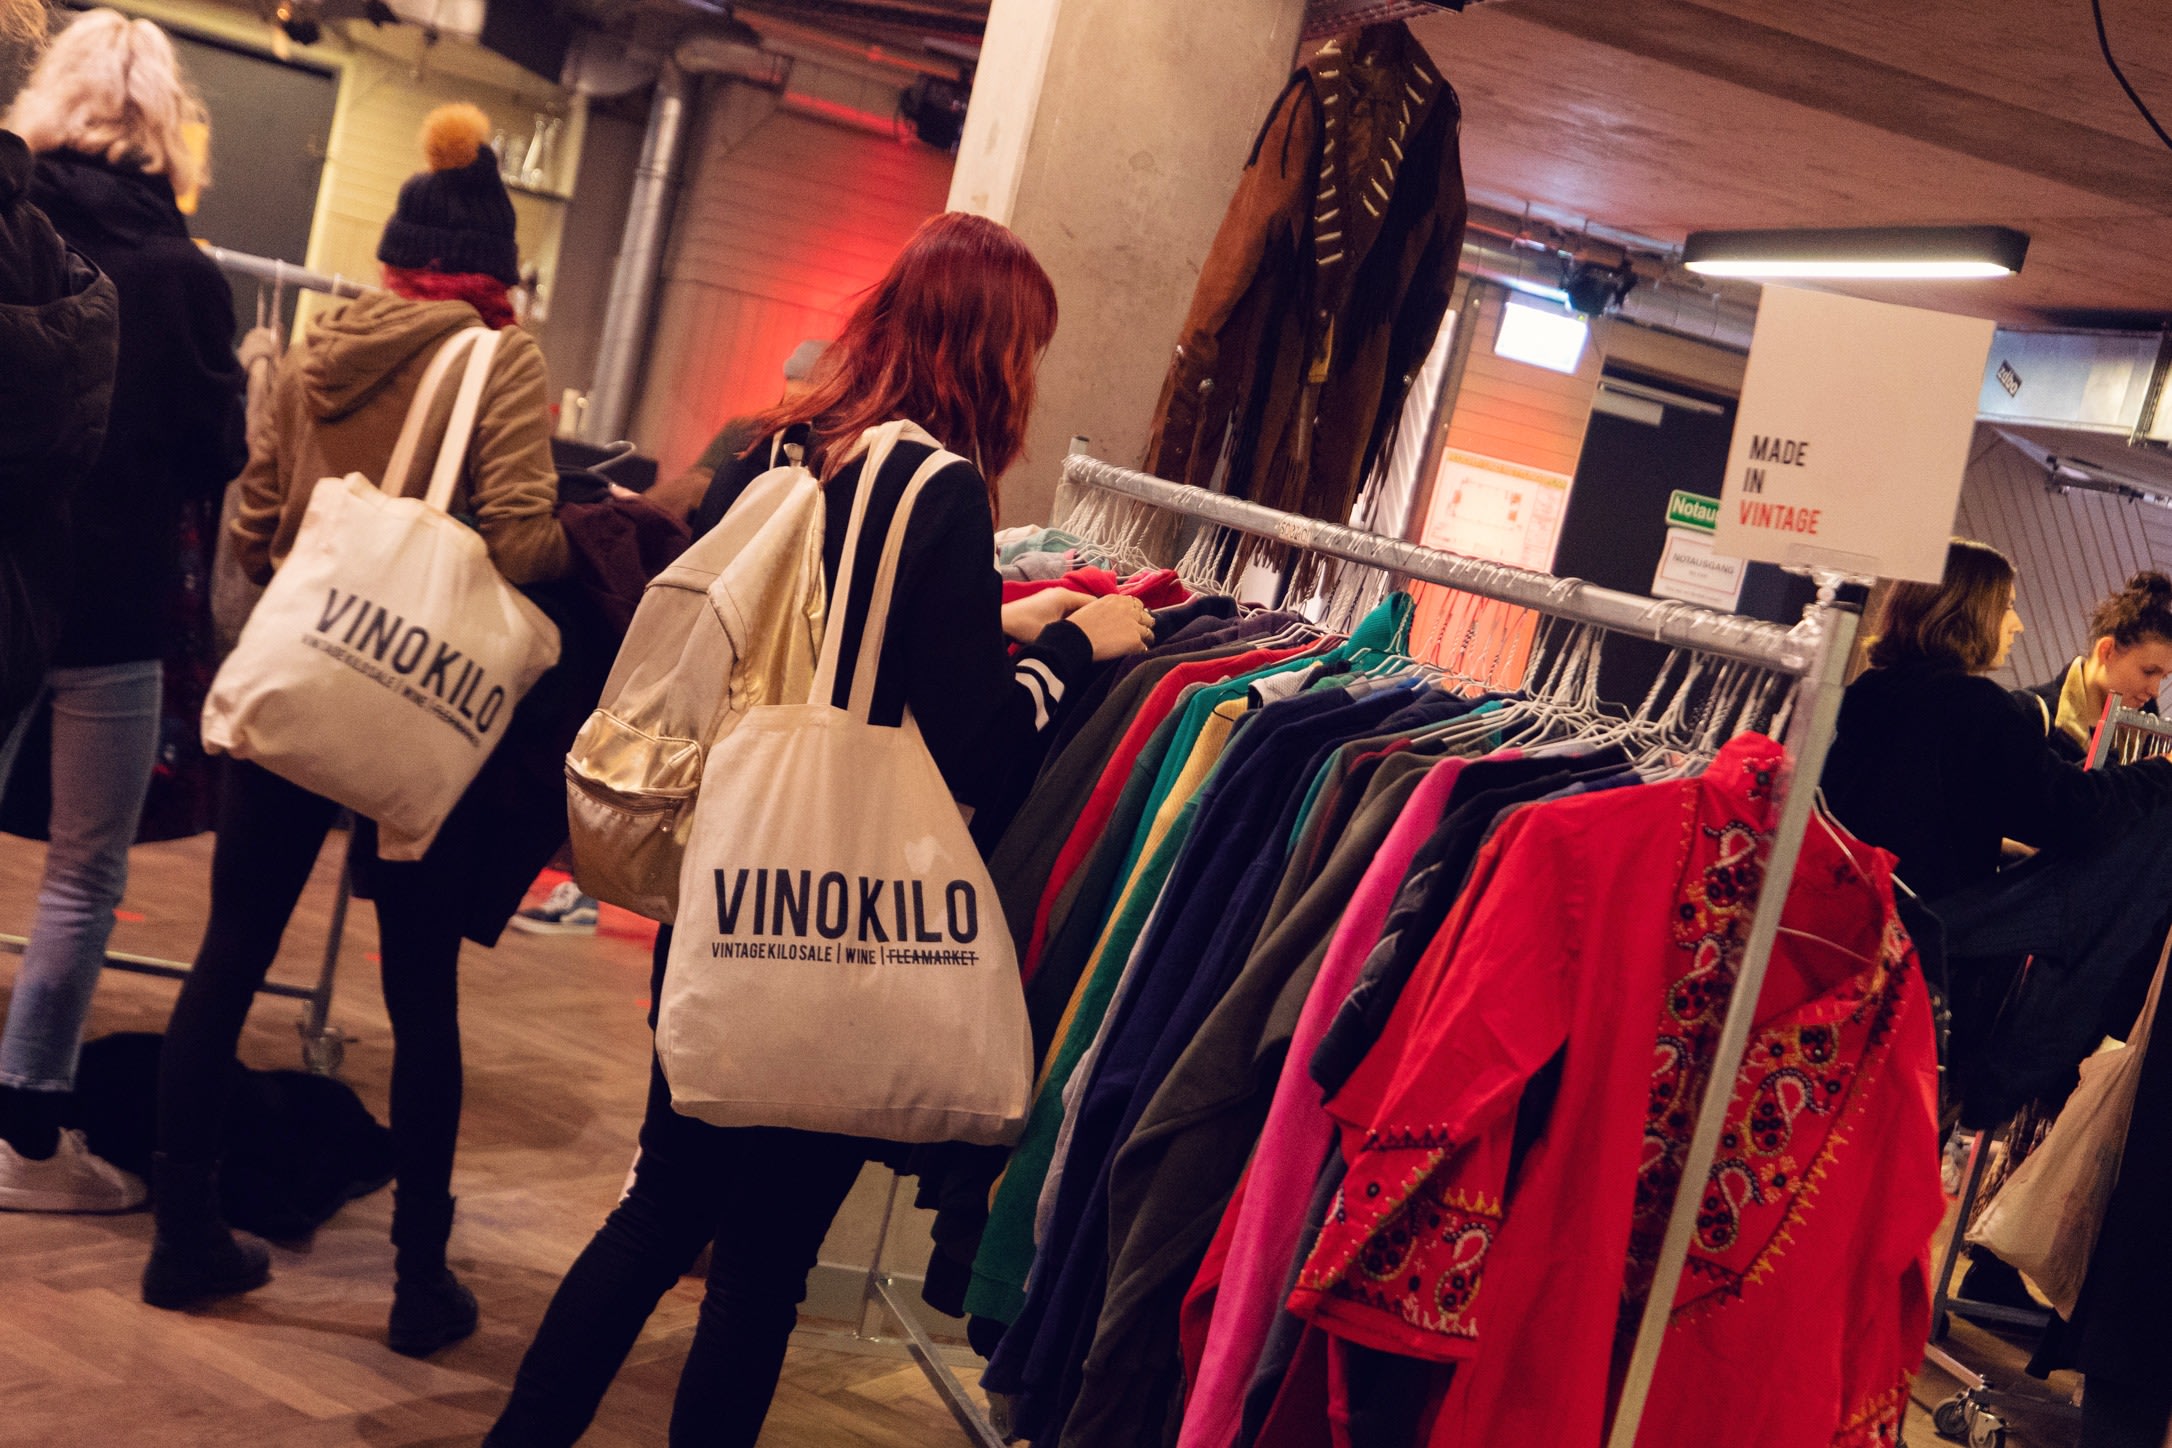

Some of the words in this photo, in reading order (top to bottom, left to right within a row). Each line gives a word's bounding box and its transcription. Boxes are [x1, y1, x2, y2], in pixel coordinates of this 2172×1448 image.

[1749, 435, 1809, 467] MADE
[1743, 467, 1766, 494] IN
[1672, 497, 1719, 521] Notau
[1739, 500, 1821, 535] VINTAGE
[316, 588, 505, 734] VINOKILO
[714, 869, 979, 944] VINOKILO
[845, 947, 876, 965] WINE
[887, 948, 977, 966] FLEAMARKET
